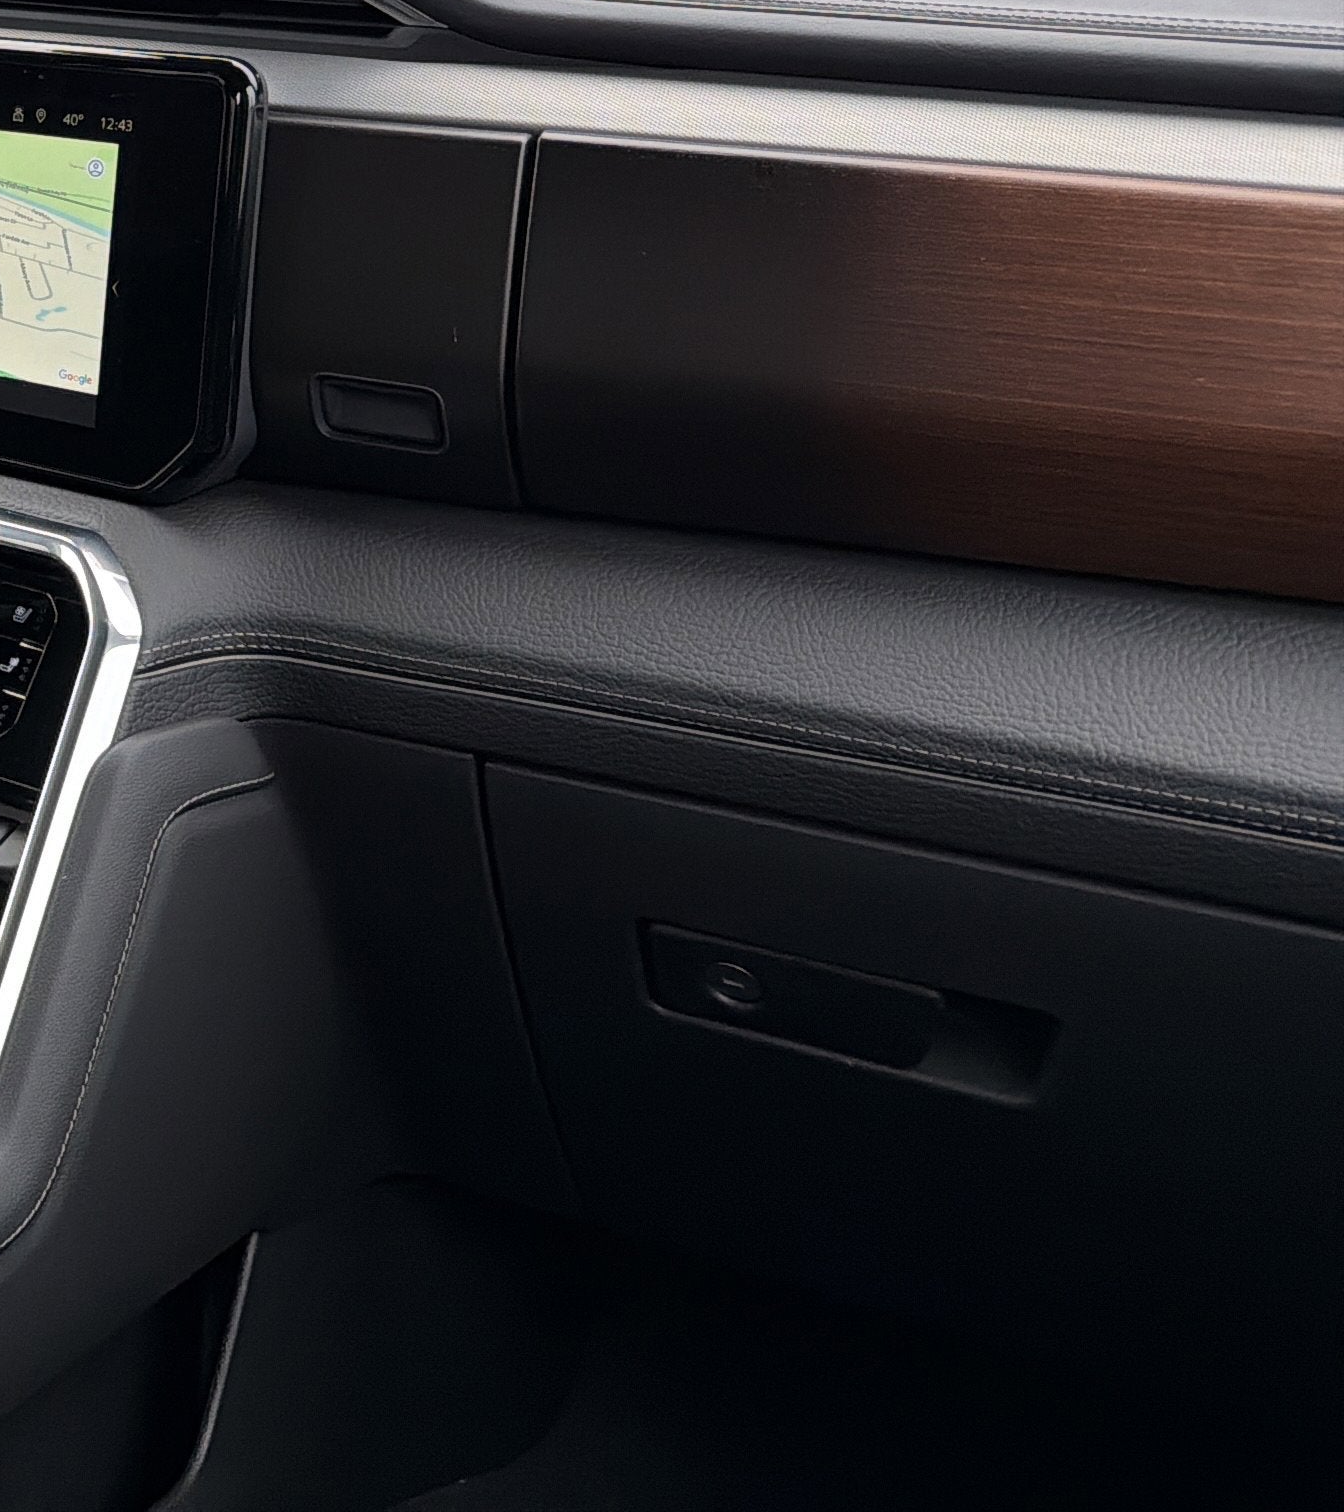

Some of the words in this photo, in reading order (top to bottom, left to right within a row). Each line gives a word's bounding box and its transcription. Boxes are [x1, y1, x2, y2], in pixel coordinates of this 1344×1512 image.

[63, 113, 85, 127] 40°
[101, 116, 134, 133] 12:43
[58, 368, 93, 386] Google
